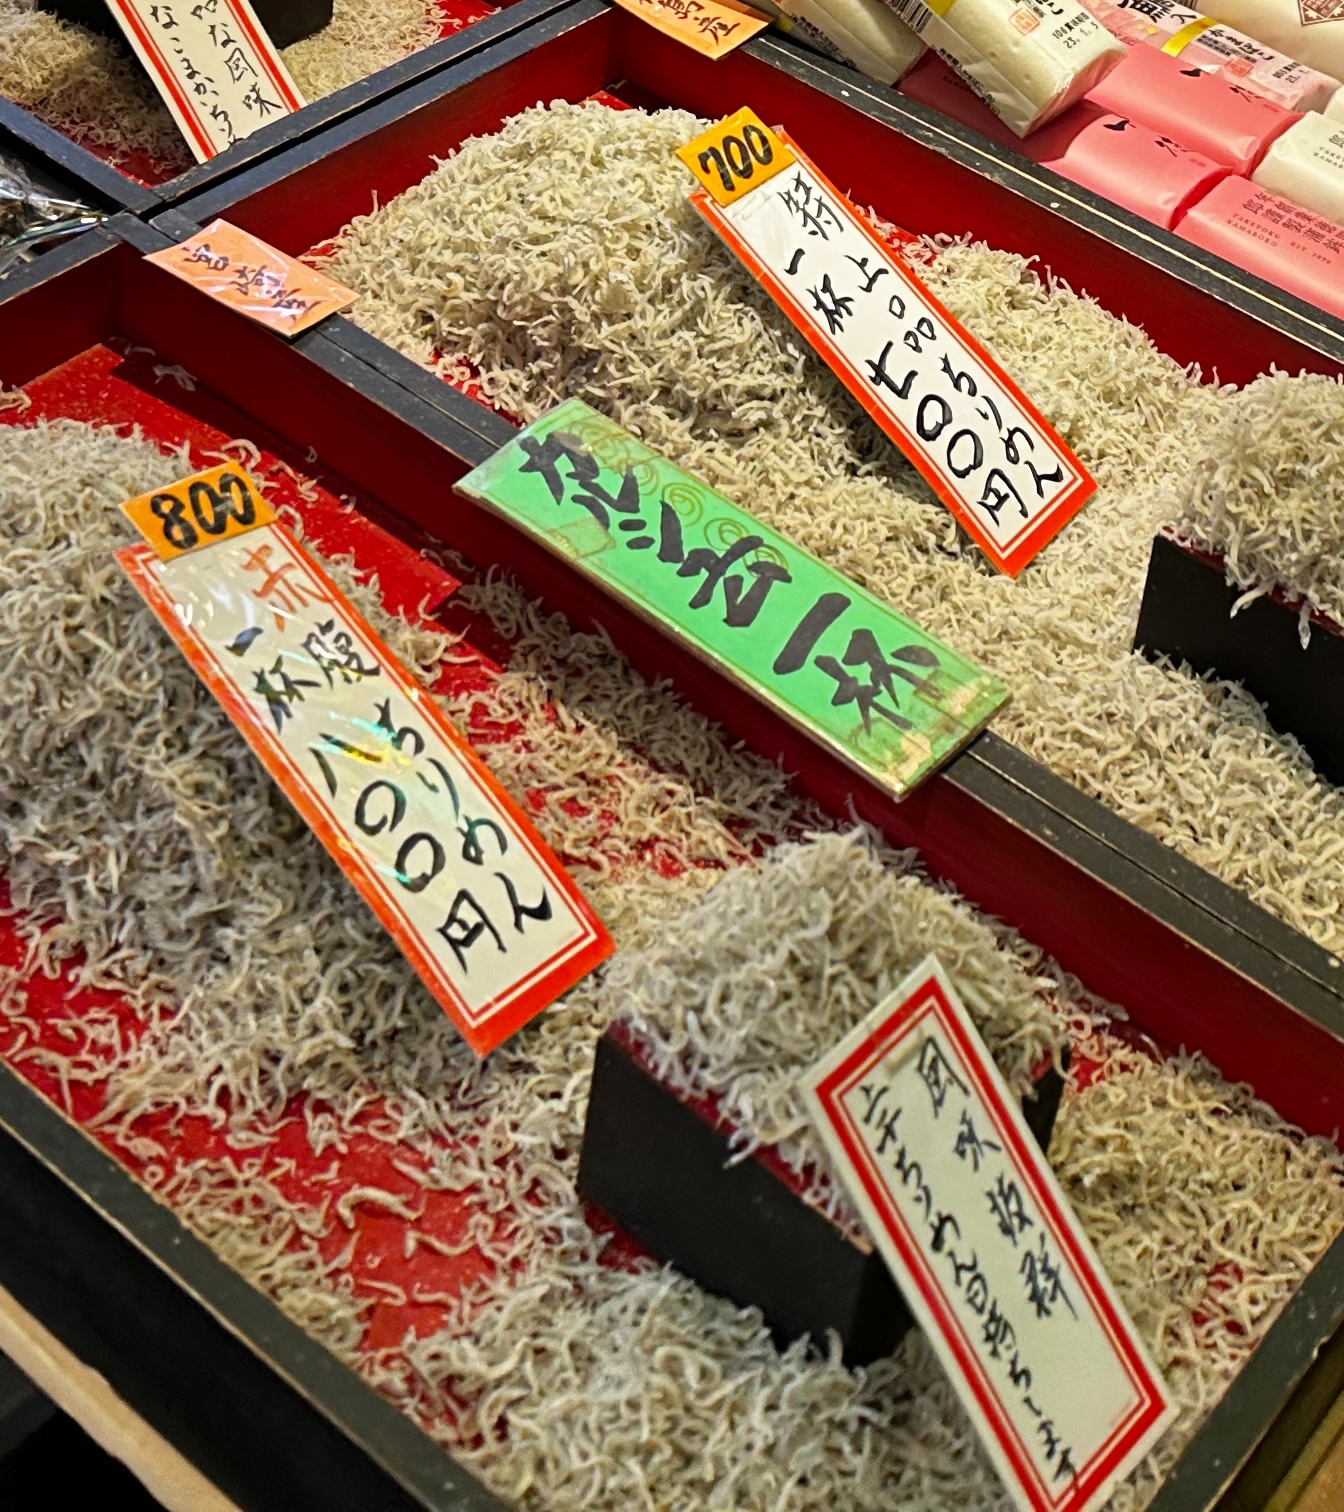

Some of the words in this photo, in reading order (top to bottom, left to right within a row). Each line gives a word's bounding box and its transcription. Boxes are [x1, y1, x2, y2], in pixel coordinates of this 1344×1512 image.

[699, 124, 776, 190] 700
[151, 473, 255, 549] 800
[916, 1035, 1079, 1322] 風味抜群
